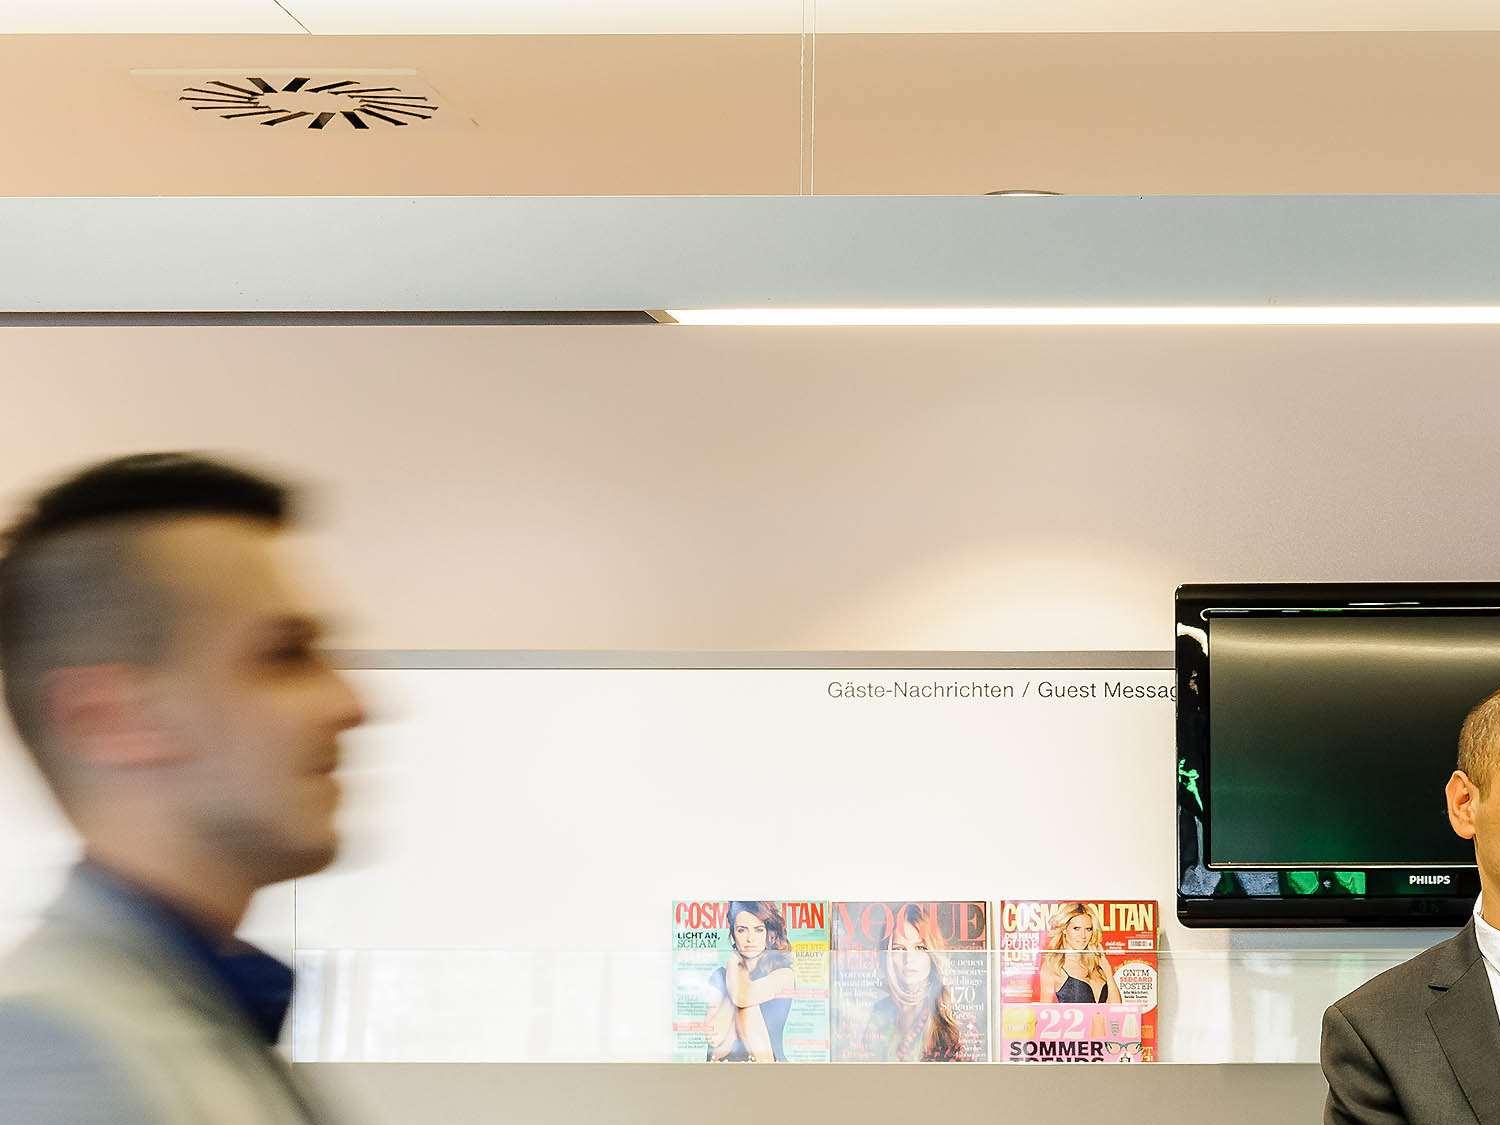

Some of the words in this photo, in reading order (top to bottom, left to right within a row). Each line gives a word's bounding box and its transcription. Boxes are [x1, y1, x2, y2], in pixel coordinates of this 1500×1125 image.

[827, 680, 1015, 699] Gäste-Nachrichten
[1022, 681, 1031, 699] /
[1037, 681, 1097, 699] Guest
[1409, 875, 1451, 885] PHILIPS
[675, 902, 825, 929] COSMITAN
[677, 931, 703, 940] LICHT
[677, 939, 717, 949] SCHAM
[1039, 1008, 1086, 1039] 22
[1010, 1041, 1104, 1056] SOMMER
